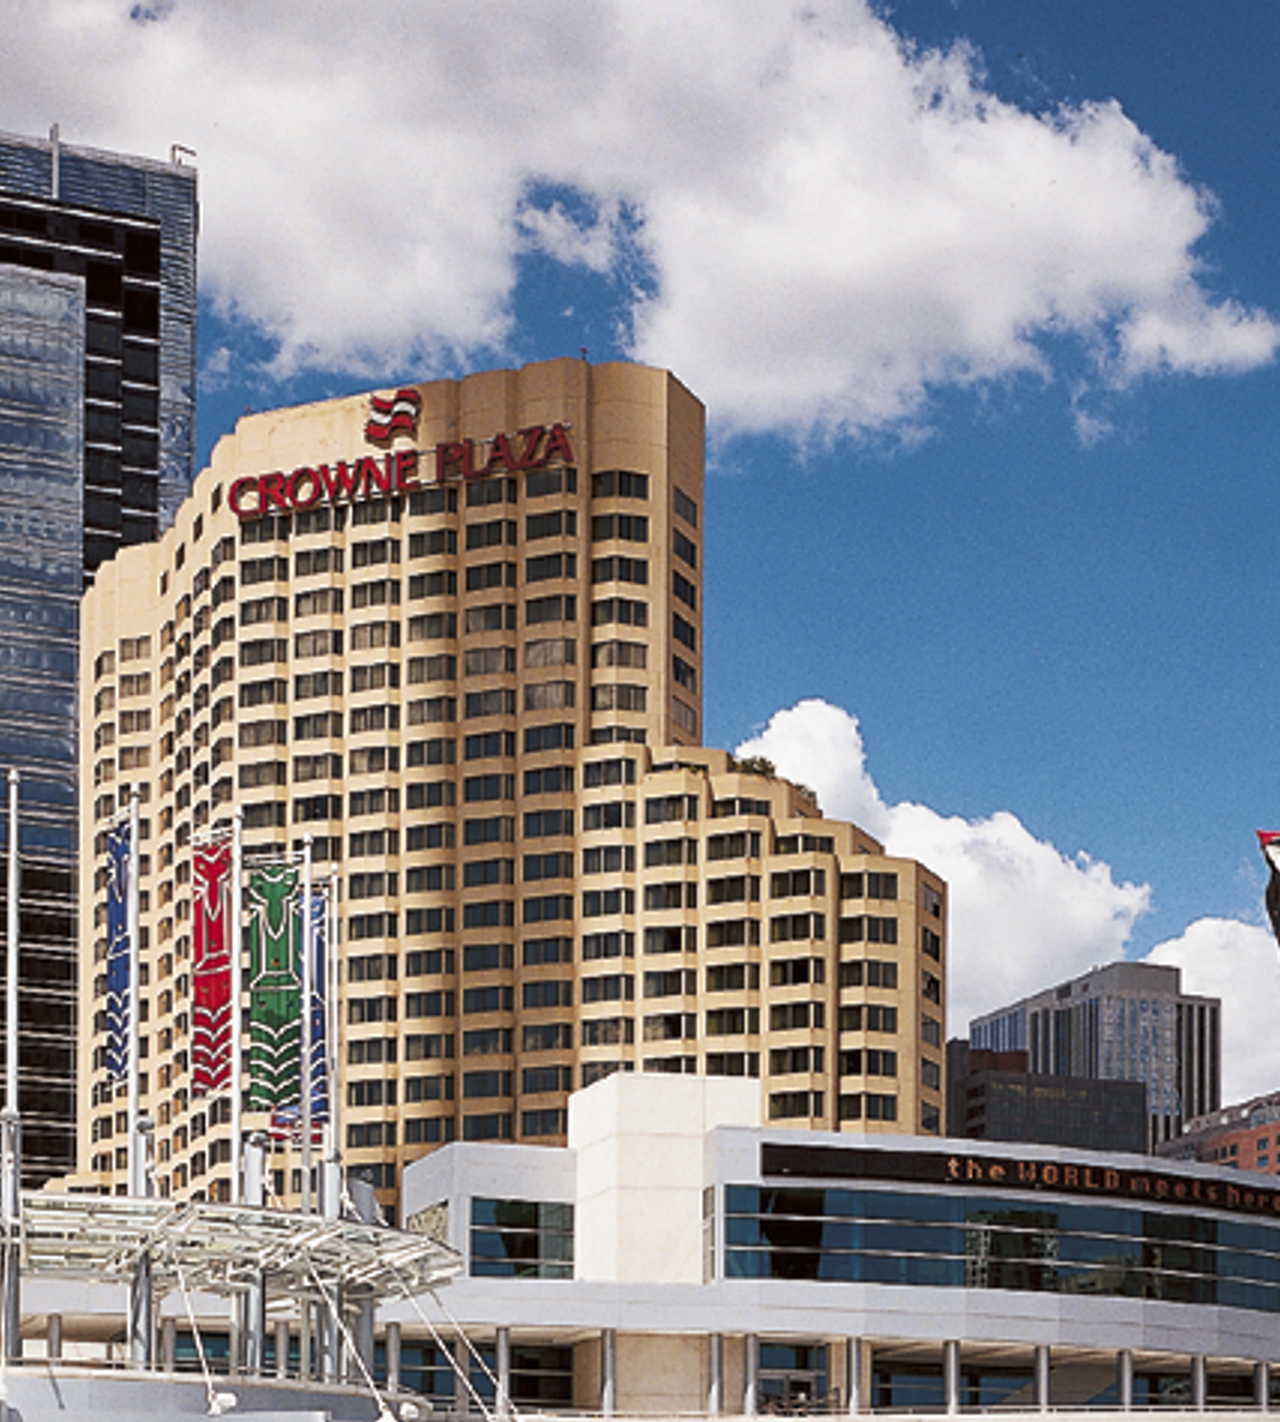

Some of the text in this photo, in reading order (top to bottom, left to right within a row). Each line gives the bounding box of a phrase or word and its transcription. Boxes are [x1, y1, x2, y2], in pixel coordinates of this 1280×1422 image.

[228, 423, 574, 516] CROWNE PLAZA
[947, 1157, 1006, 1181] the
[1019, 1161, 1120, 1189] WORLD
[1130, 1176, 1217, 1200] meets
